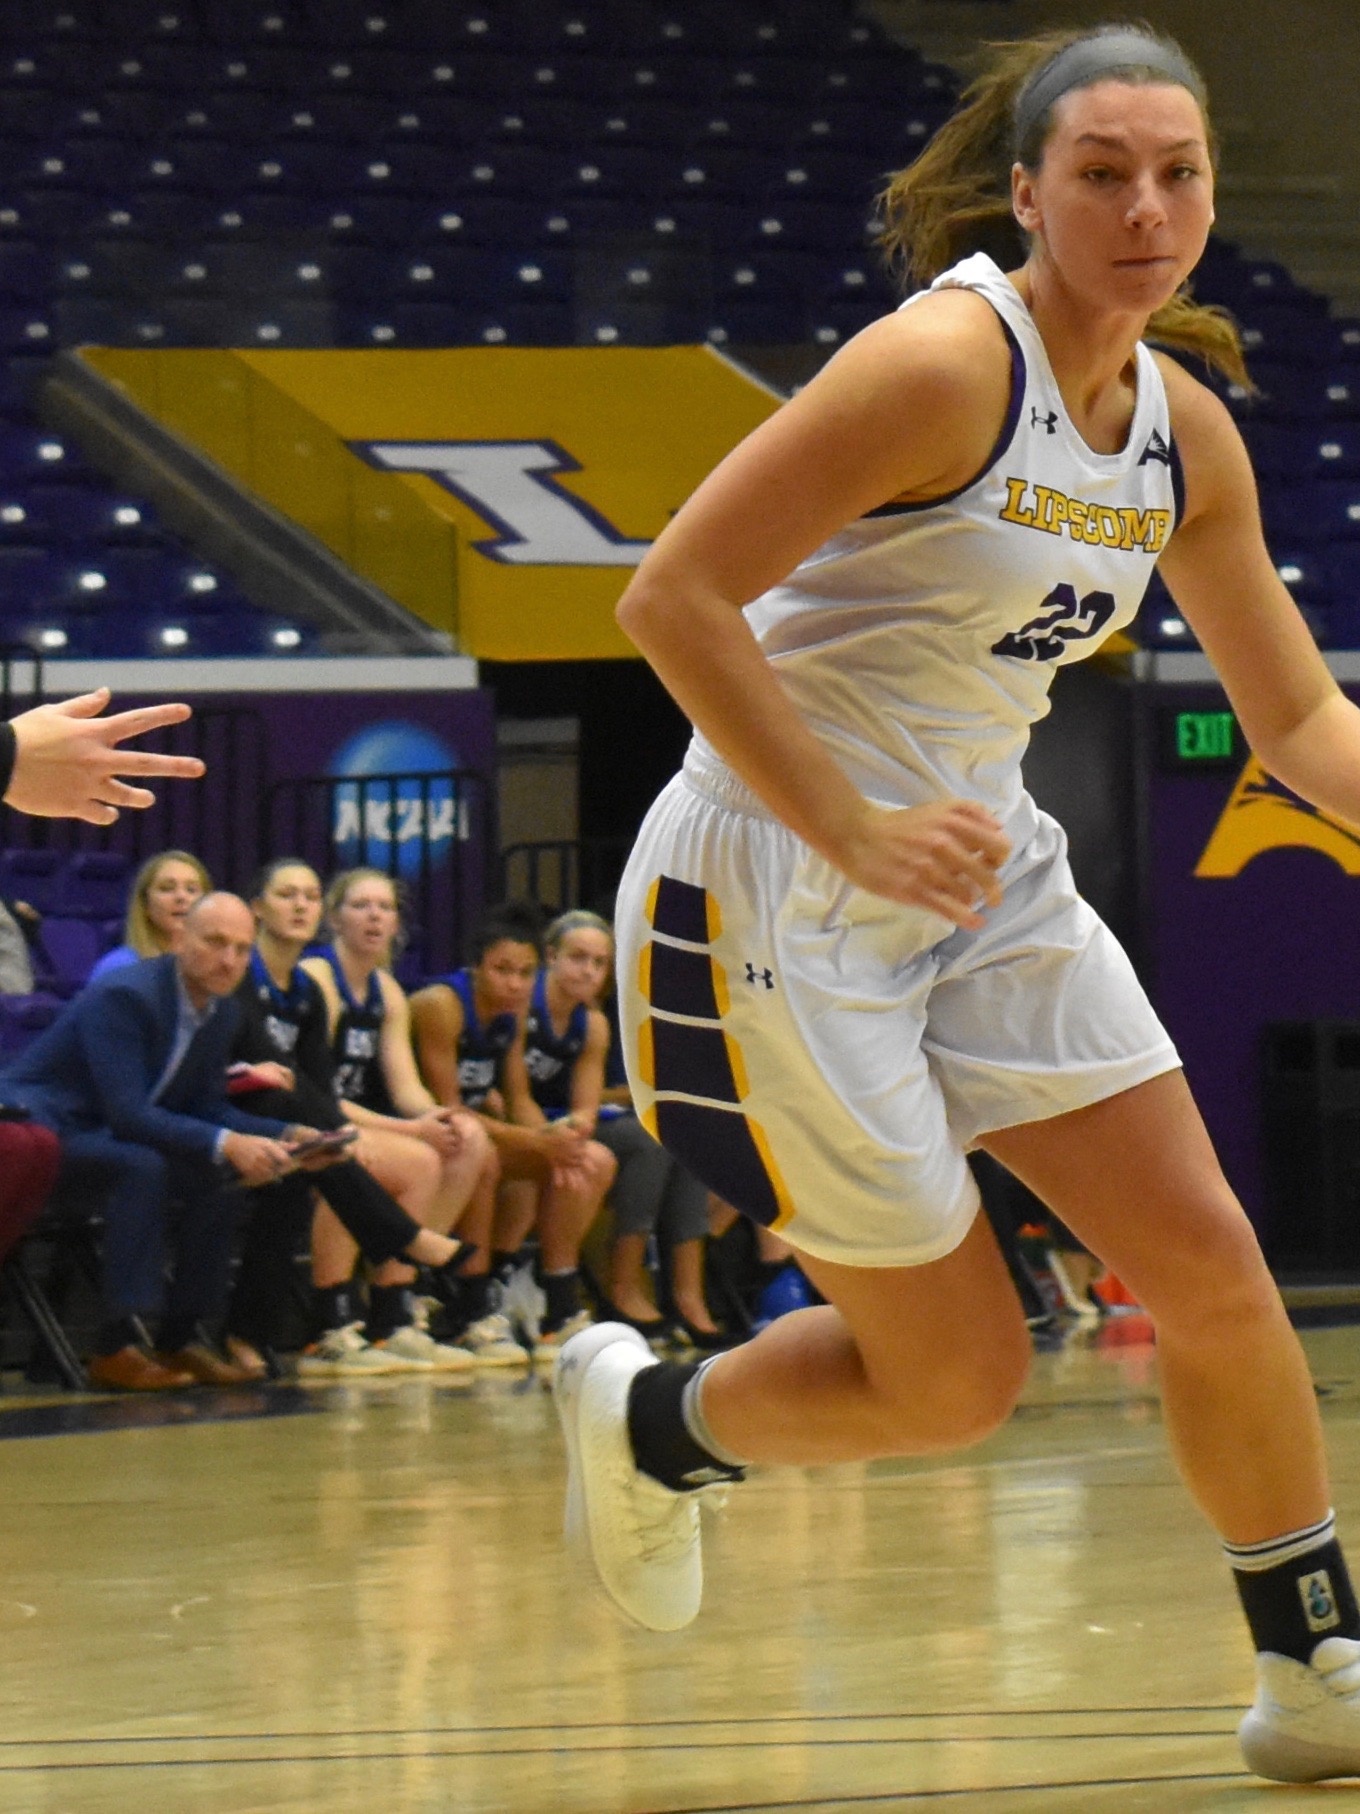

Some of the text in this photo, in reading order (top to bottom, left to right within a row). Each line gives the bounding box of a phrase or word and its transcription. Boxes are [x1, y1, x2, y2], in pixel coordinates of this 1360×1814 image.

[999, 477, 1170, 553] LIPSCOMB
[990, 582, 1116, 662] 22
[1178, 712, 1234, 757] EXIT
